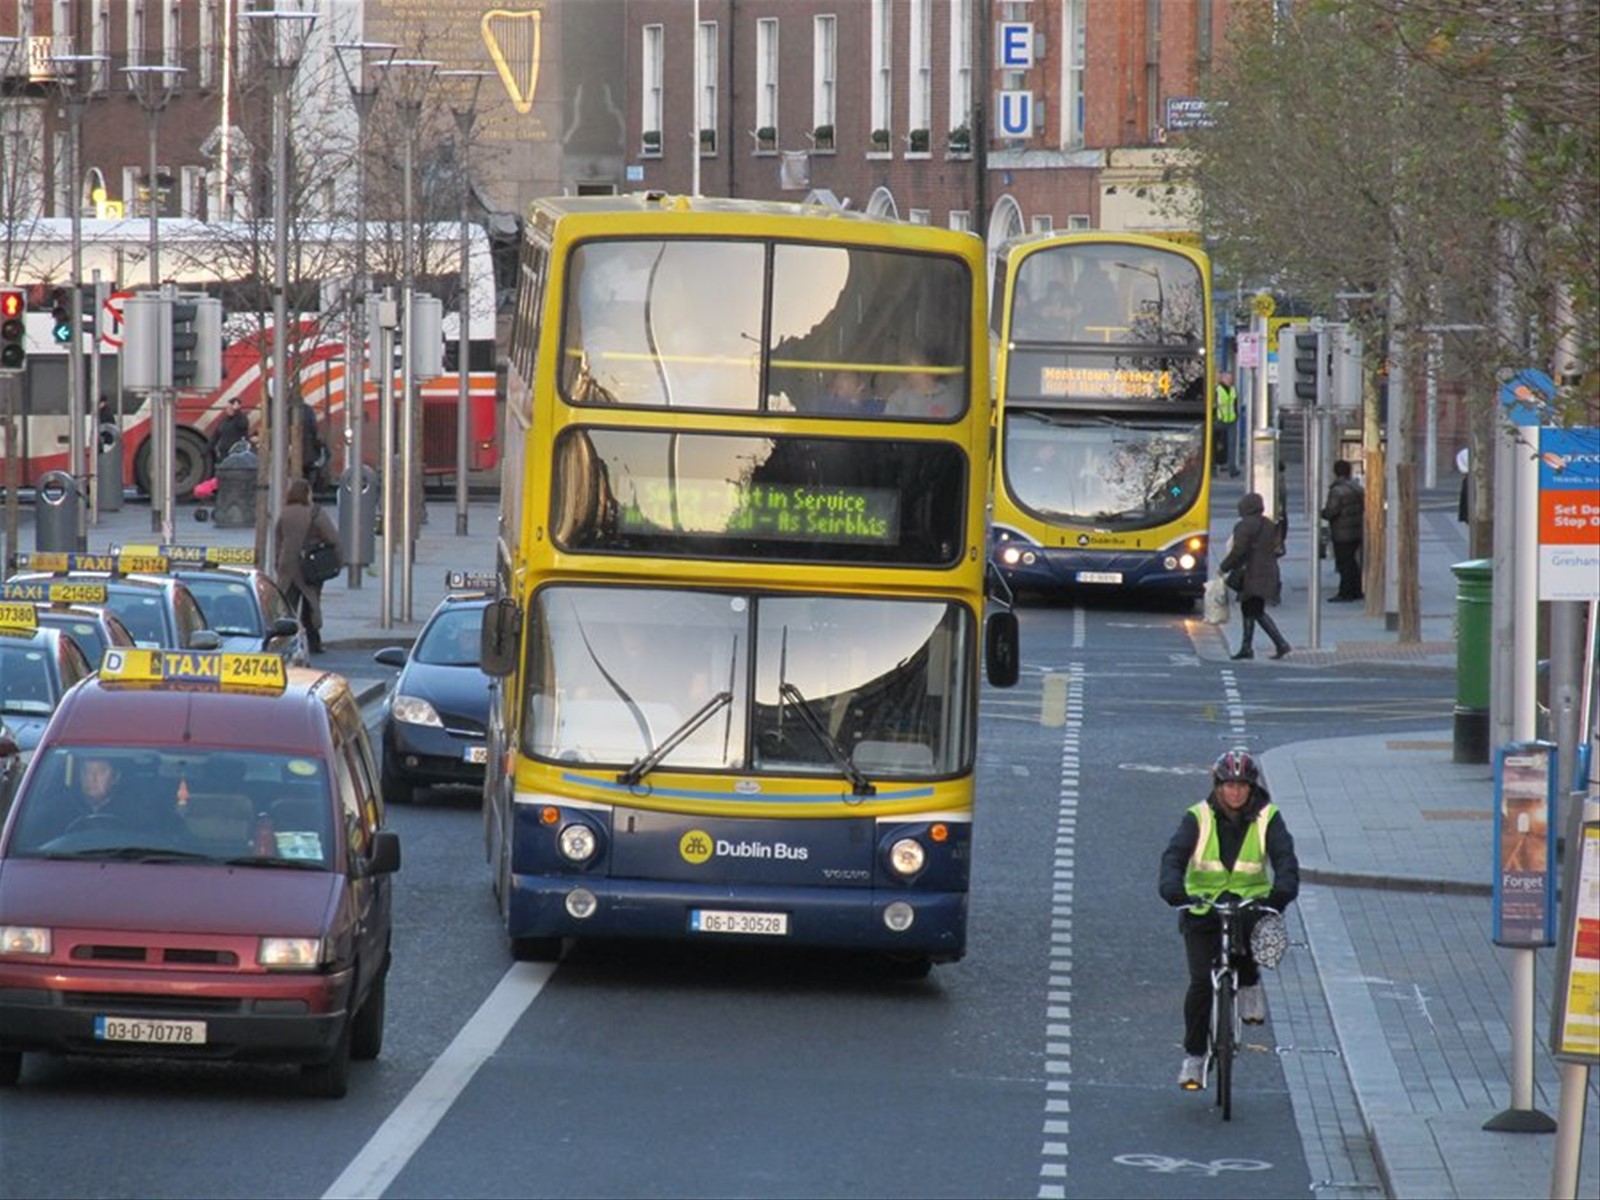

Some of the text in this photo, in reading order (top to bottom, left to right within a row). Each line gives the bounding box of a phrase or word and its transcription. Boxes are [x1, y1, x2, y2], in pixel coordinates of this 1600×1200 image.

[769, 487, 787, 508] in
[794, 488, 865, 513] Service
[1554, 505, 1577, 515] Set
[1554, 516, 1586, 529] Stop
[167, 546, 199, 561] TAXI
[75, 556, 112, 570] TAXI
[2, 585, 42, 599] TAXI
[106, 653, 278, 676] D TAXI 24744
[716, 840, 808, 860] Dublin Bus
[822, 869, 870, 879] VOLVO
[1503, 874, 1543, 889] Forget
[705, 915, 781, 932] 06-D-30528
[107, 1022, 193, 1041] 03-D-70778
